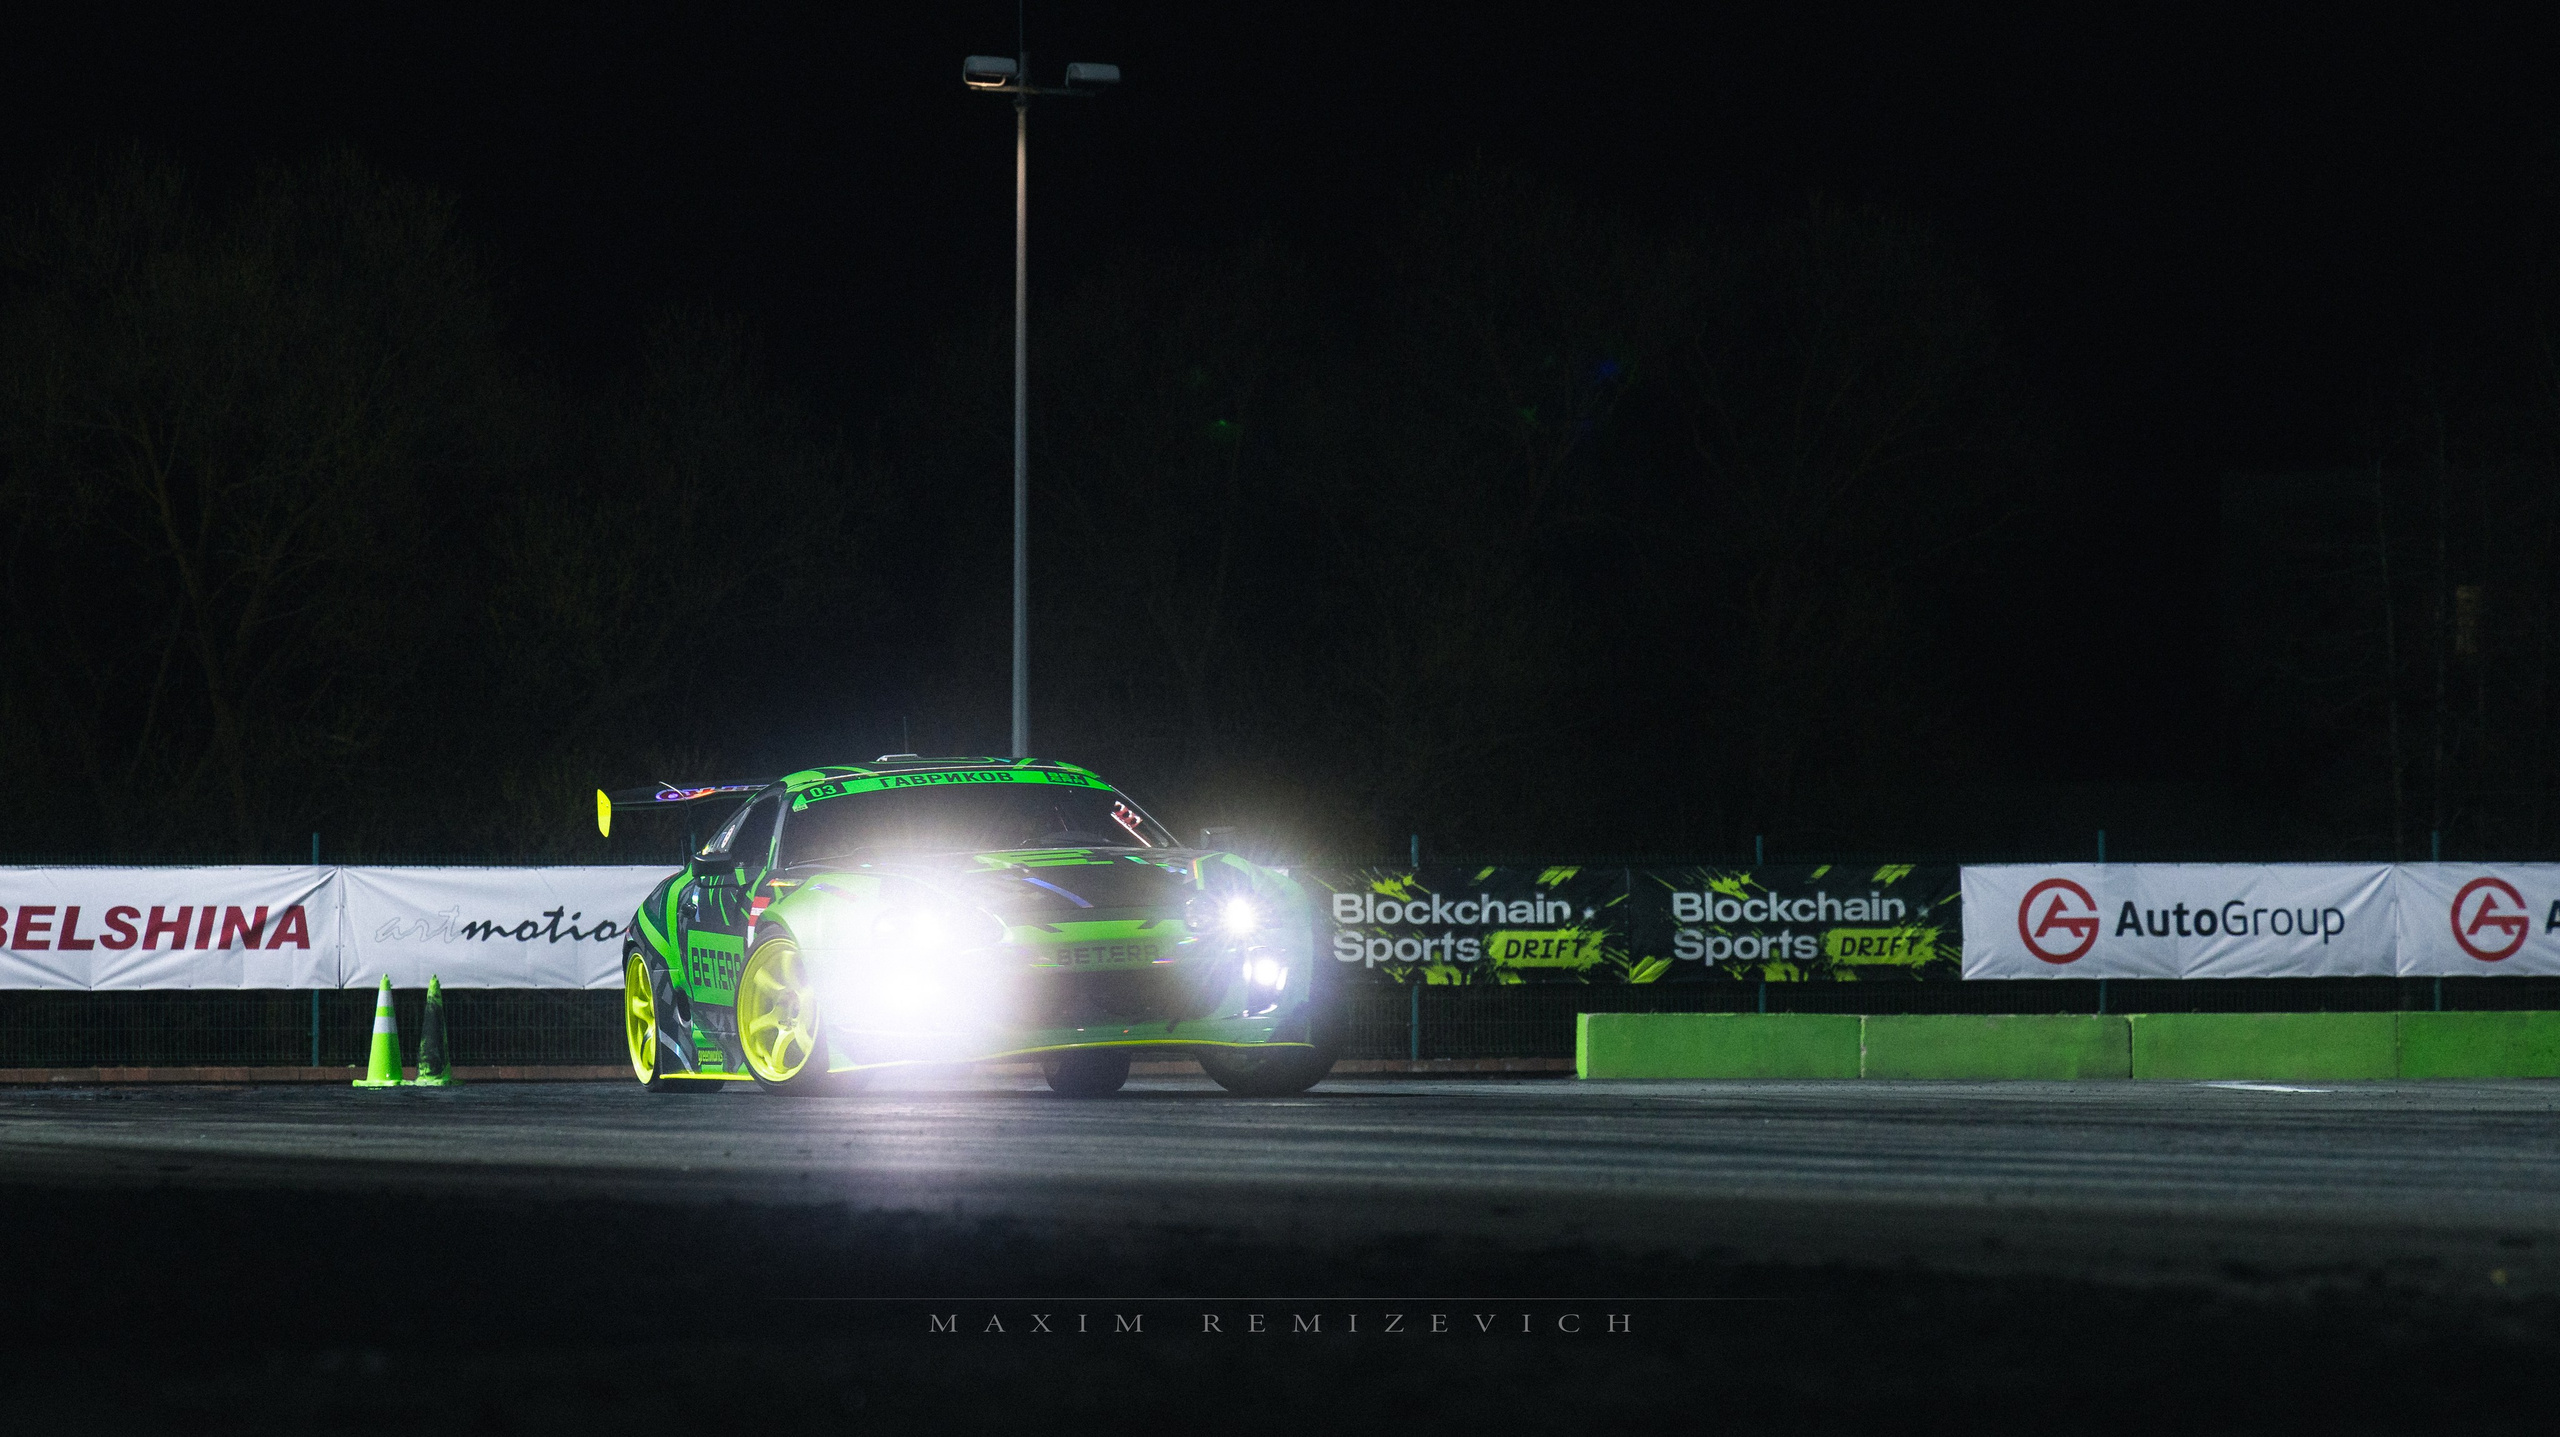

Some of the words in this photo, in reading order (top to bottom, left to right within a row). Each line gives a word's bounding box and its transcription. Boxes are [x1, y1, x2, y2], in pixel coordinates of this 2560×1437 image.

[810, 784, 837, 799] 03
[880, 771, 1015, 789] ГАВРИКОВ
[375, 904, 629, 944] artmotio
[1332, 893, 1572, 925] Blockchain
[1672, 891, 1907, 923] Blockchain
[2115, 900, 2345, 944] AutoGroup
[0, 905, 312, 951] ELSHINA
[1332, 929, 1482, 969] Sports
[1504, 938, 1588, 960] DRIFT
[1673, 929, 1819, 967] Sports
[1840, 936, 1922, 958] DRIFT
